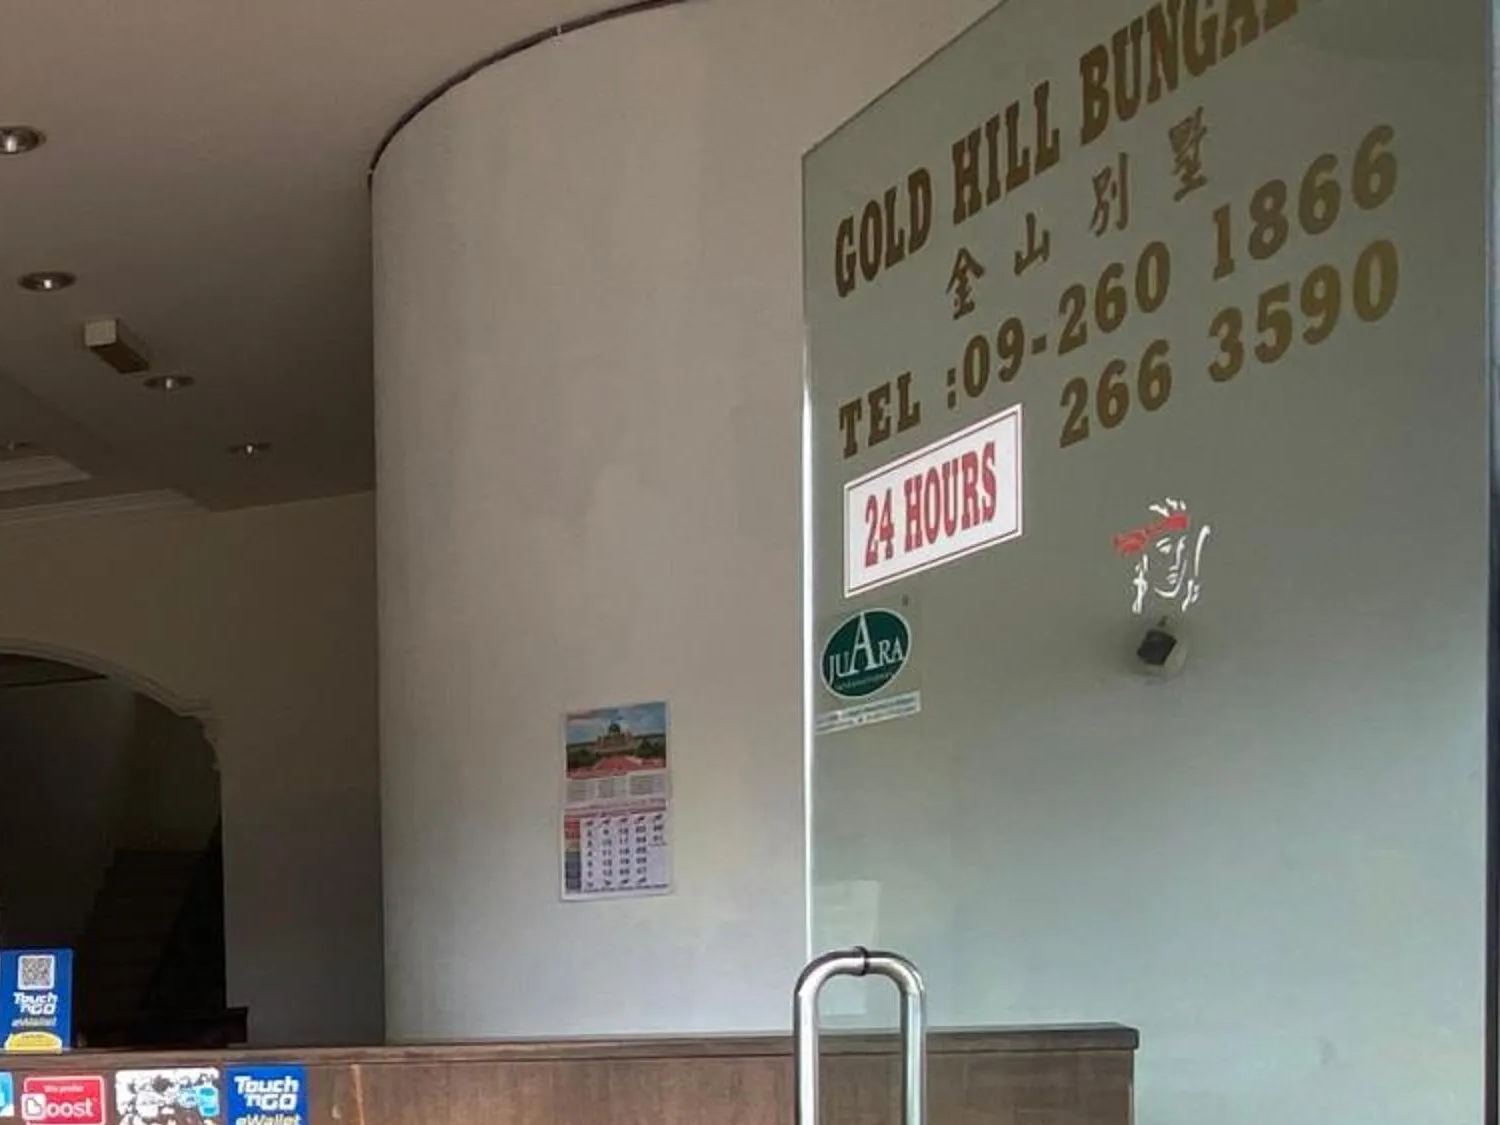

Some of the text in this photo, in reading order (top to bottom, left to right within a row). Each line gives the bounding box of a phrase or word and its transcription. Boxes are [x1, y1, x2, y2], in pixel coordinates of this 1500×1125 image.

[834, 167, 932, 298] GOLD
[951, 80, 1060, 225] HILL
[839, 371, 921, 459] TEL
[1211, 124, 1398, 280] 1866
[1059, 239, 1399, 448] 266 3590
[865, 441, 997, 568] 24 HOURS
[234, 1075, 299, 1095] Touch
